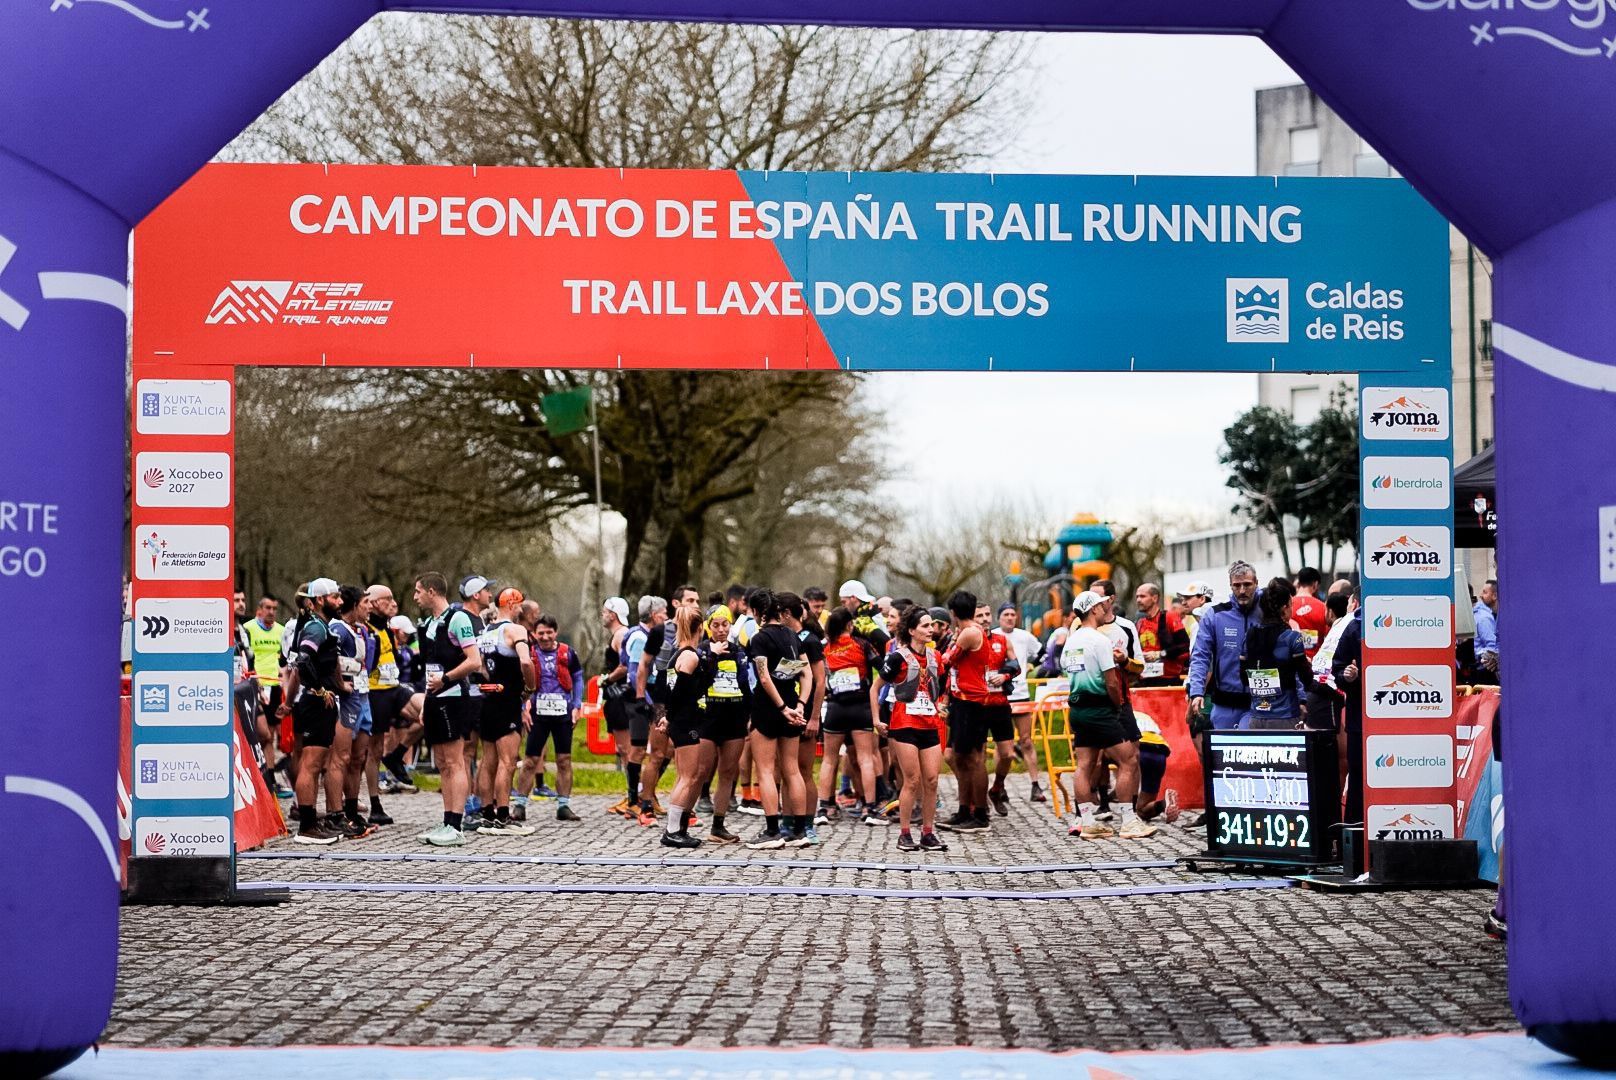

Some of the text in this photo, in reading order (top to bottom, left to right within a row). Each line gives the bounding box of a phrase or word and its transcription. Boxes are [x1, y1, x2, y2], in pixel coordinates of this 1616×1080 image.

[290, 194, 1302, 243] CAMPEONATO DE ESPAÑA TRAIL RUNNING
[563, 280, 1050, 317] TRAIL LAXE DOS BOLOS
[1306, 281, 1404, 309] Caldas
[286, 299, 393, 311] ATLETISMO
[282, 314, 388, 326] TRAIL RUNNING
[1306, 313, 1404, 340] de Reis
[164, 395, 202, 405] XUNTA
[163, 406, 226, 416] DE GALICIA
[168, 468, 224, 480] Xacobeo
[168, 483, 195, 494] 2027
[1393, 477, 1443, 489] Iberdrola
[161, 550, 226, 561] Federación Galega
[170, 558, 206, 567] Atletismo
[173, 617, 223, 628] Deputación
[1395, 616, 1444, 628] Iberdrola
[173, 626, 223, 634] Pontevedra
[177, 685, 224, 698] Caldas
[177, 699, 224, 711] de Reis
[162, 761, 201, 771] XUNTA
[1397, 756, 1447, 767] Iberdrola
[161, 772, 225, 782] DE GALICIA
[169, 832, 225, 844] Xacobeo
[170, 848, 196, 856] 2027
